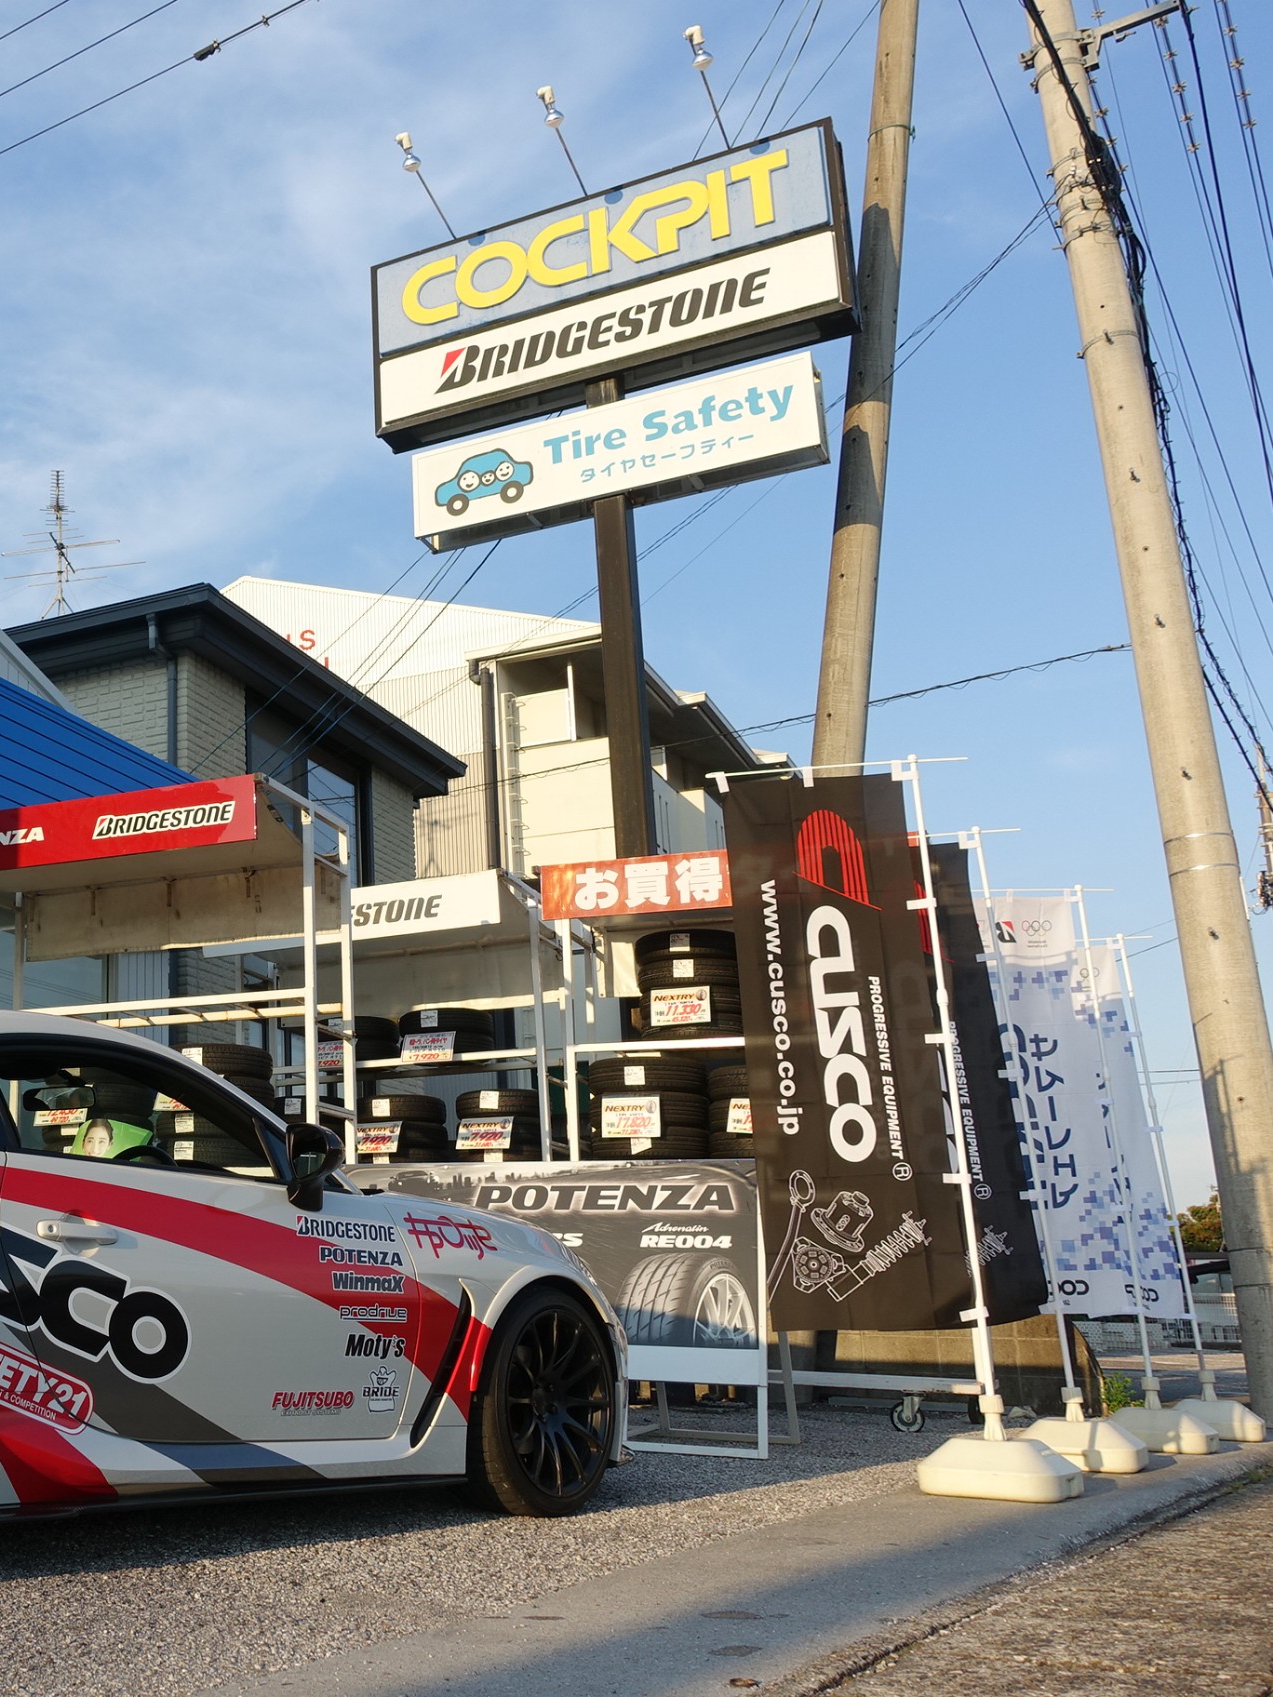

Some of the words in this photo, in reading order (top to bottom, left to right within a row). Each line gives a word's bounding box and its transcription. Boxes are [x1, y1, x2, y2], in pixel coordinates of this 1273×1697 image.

[402, 148, 789, 325] COCKPIT
[433, 267, 771, 395] BRIDGESTONE
[543, 427, 627, 464] Tire
[641, 384, 794, 443] Safety
[580, 433, 756, 483] タイヤセーフティー
[95, 802, 235, 838] BRIDGESTONE
[574, 858, 724, 909] お買得
[760, 878, 803, 1136] www.cusco.co.jp
[868, 976, 893, 1073] PROGRESSIVE
[881, 1074, 904, 1160] EQUIPMENT
[477, 1185, 736, 1211] POTENZA
[297, 1215, 396, 1243] BRIDGESTONE
[639, 1235, 733, 1249] RE004
[320, 1247, 403, 1267] POTENZA
[340, 1303, 408, 1321] prodrive
[345, 1334, 406, 1359] Moty's
[272, 1391, 354, 1409] FUJITSUBO
[362, 1386, 400, 1398] BRIDE
[10, 1393, 57, 1421] COMPETITION
